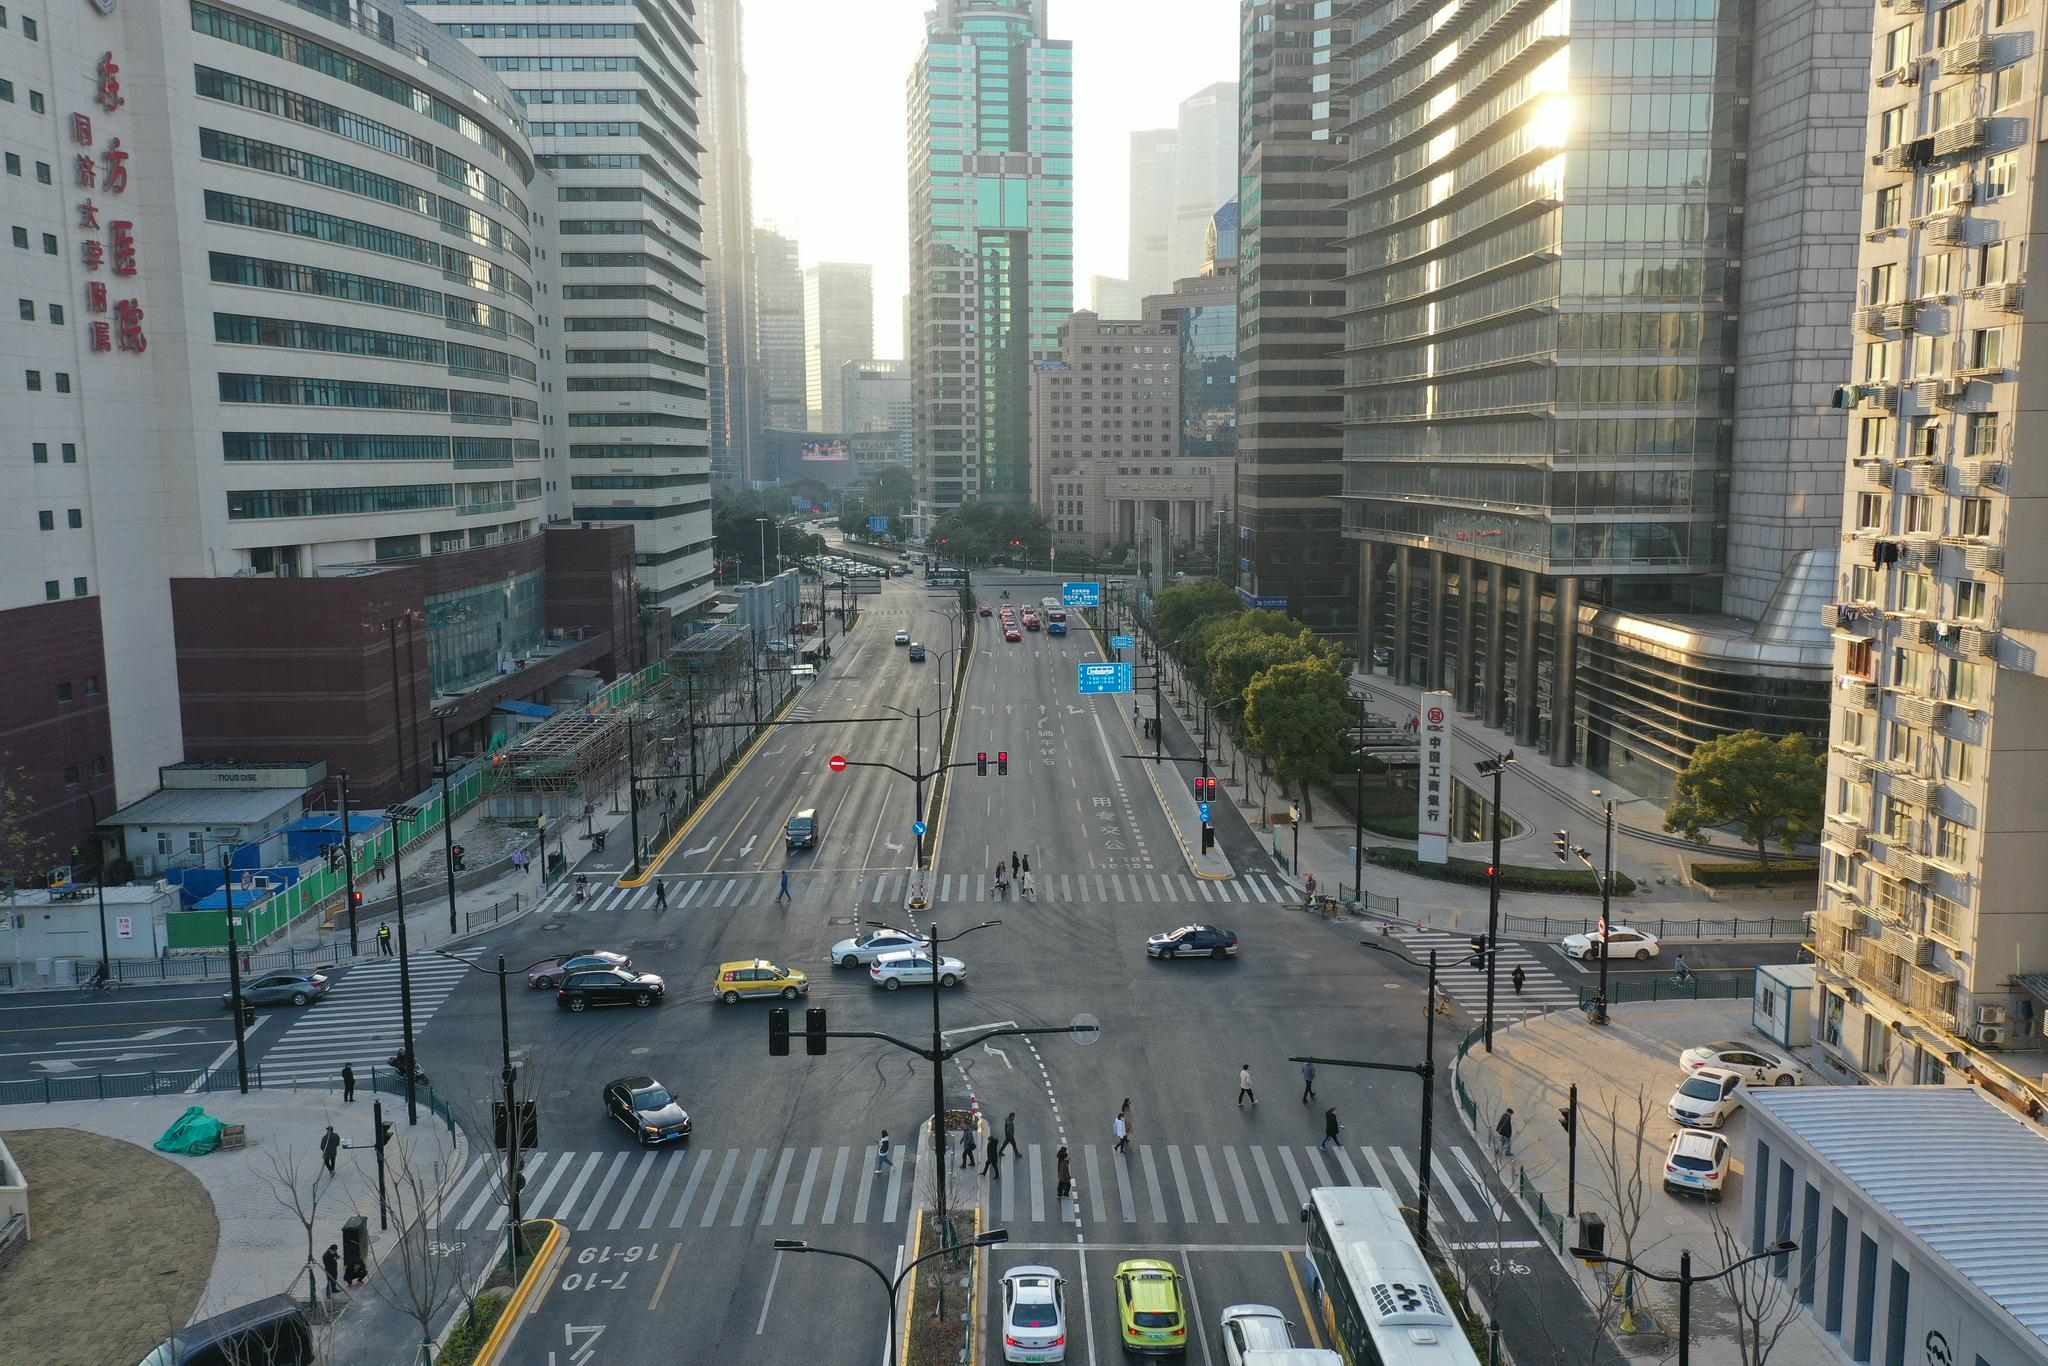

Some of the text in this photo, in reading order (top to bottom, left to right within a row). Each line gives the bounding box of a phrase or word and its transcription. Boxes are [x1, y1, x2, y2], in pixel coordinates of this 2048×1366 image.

[98, 51, 147, 353] 东方医院
[1427, 724, 1444, 732] ICBC
[1428, 737, 1441, 821] 中国工商银行
[577, 1243, 659, 1265] 16-19
[562, 1271, 630, 1291] 7-10
